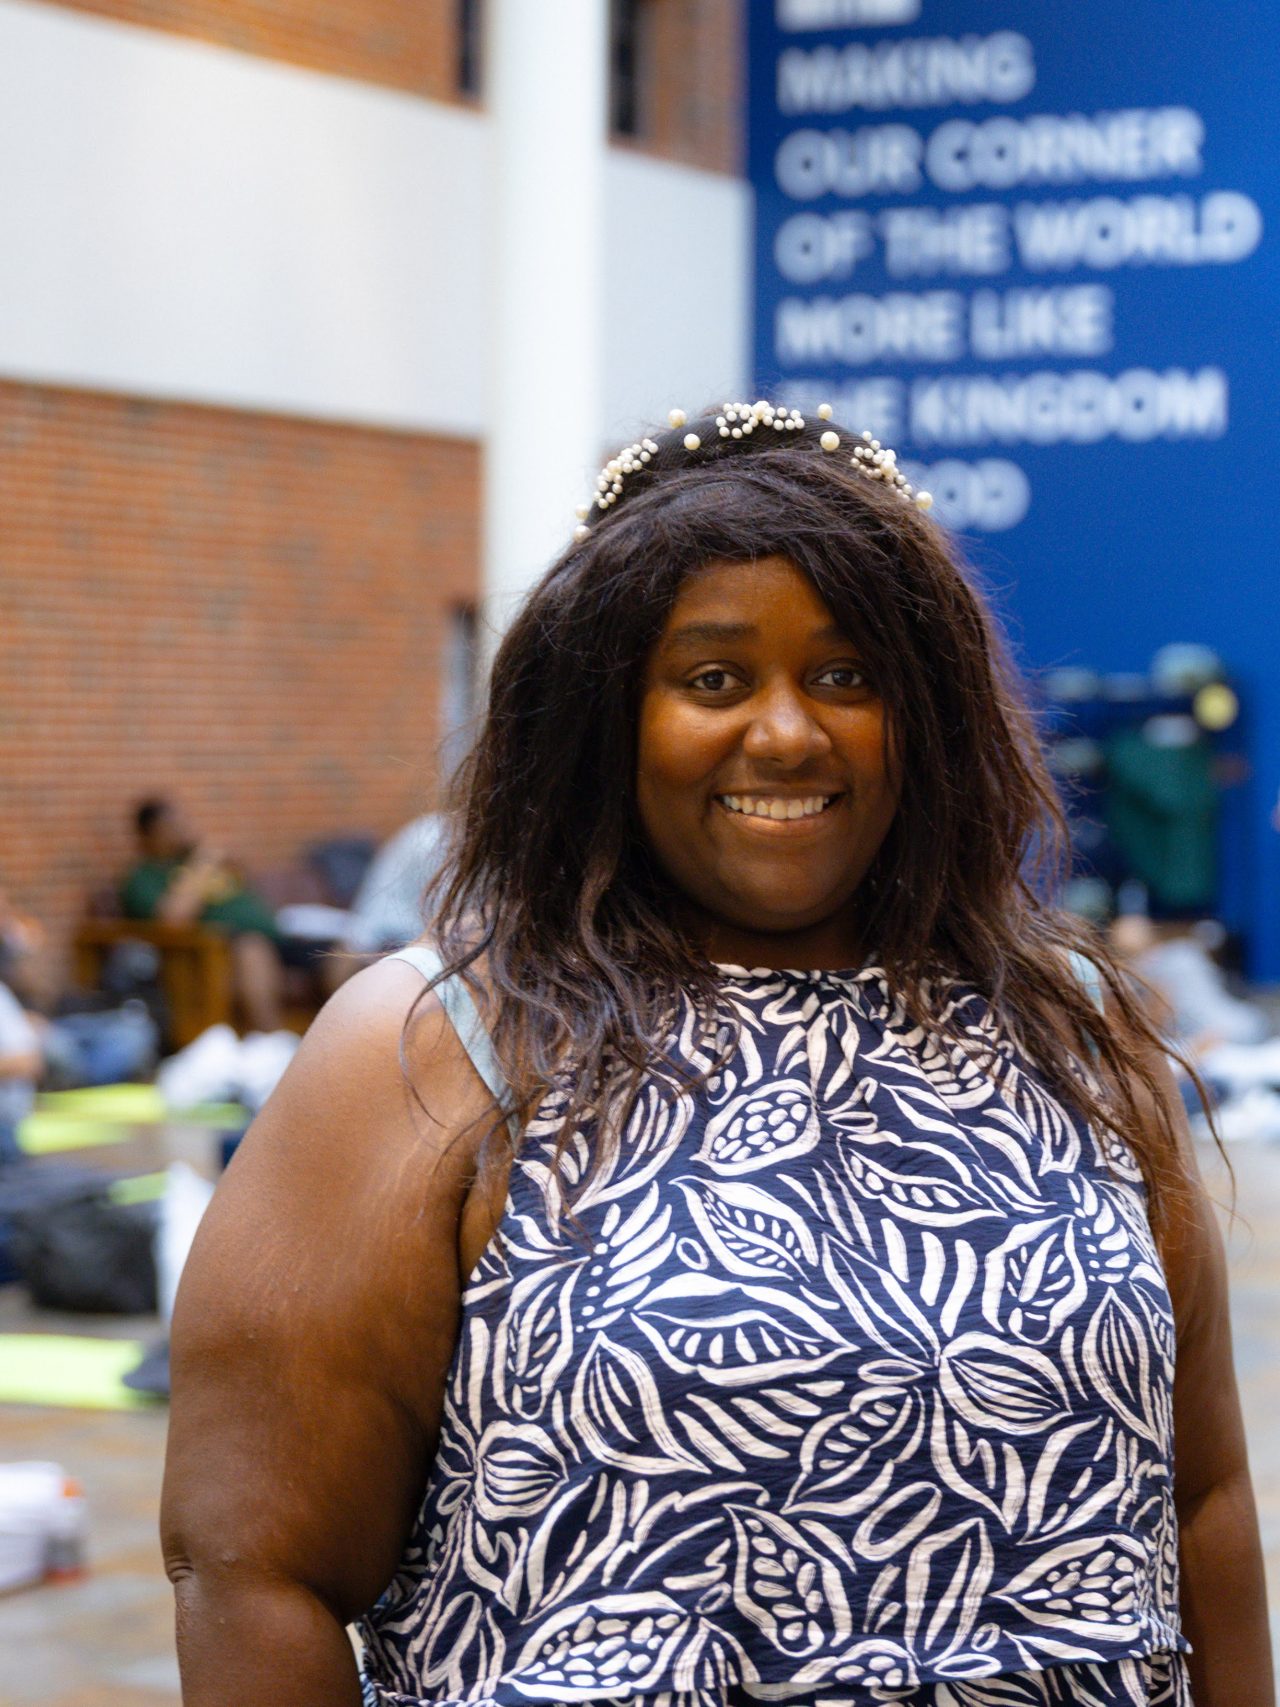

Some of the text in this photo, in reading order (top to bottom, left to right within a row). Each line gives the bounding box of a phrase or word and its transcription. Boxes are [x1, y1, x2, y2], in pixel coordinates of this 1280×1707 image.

[779, 33, 1033, 113] MAKING
[777, 108, 1202, 198] OUR CORNER
[776, 191, 1262, 282] OF THE WORLD
[777, 285, 1111, 364] MORE LIKE
[910, 369, 1228, 443] KINGDOM
